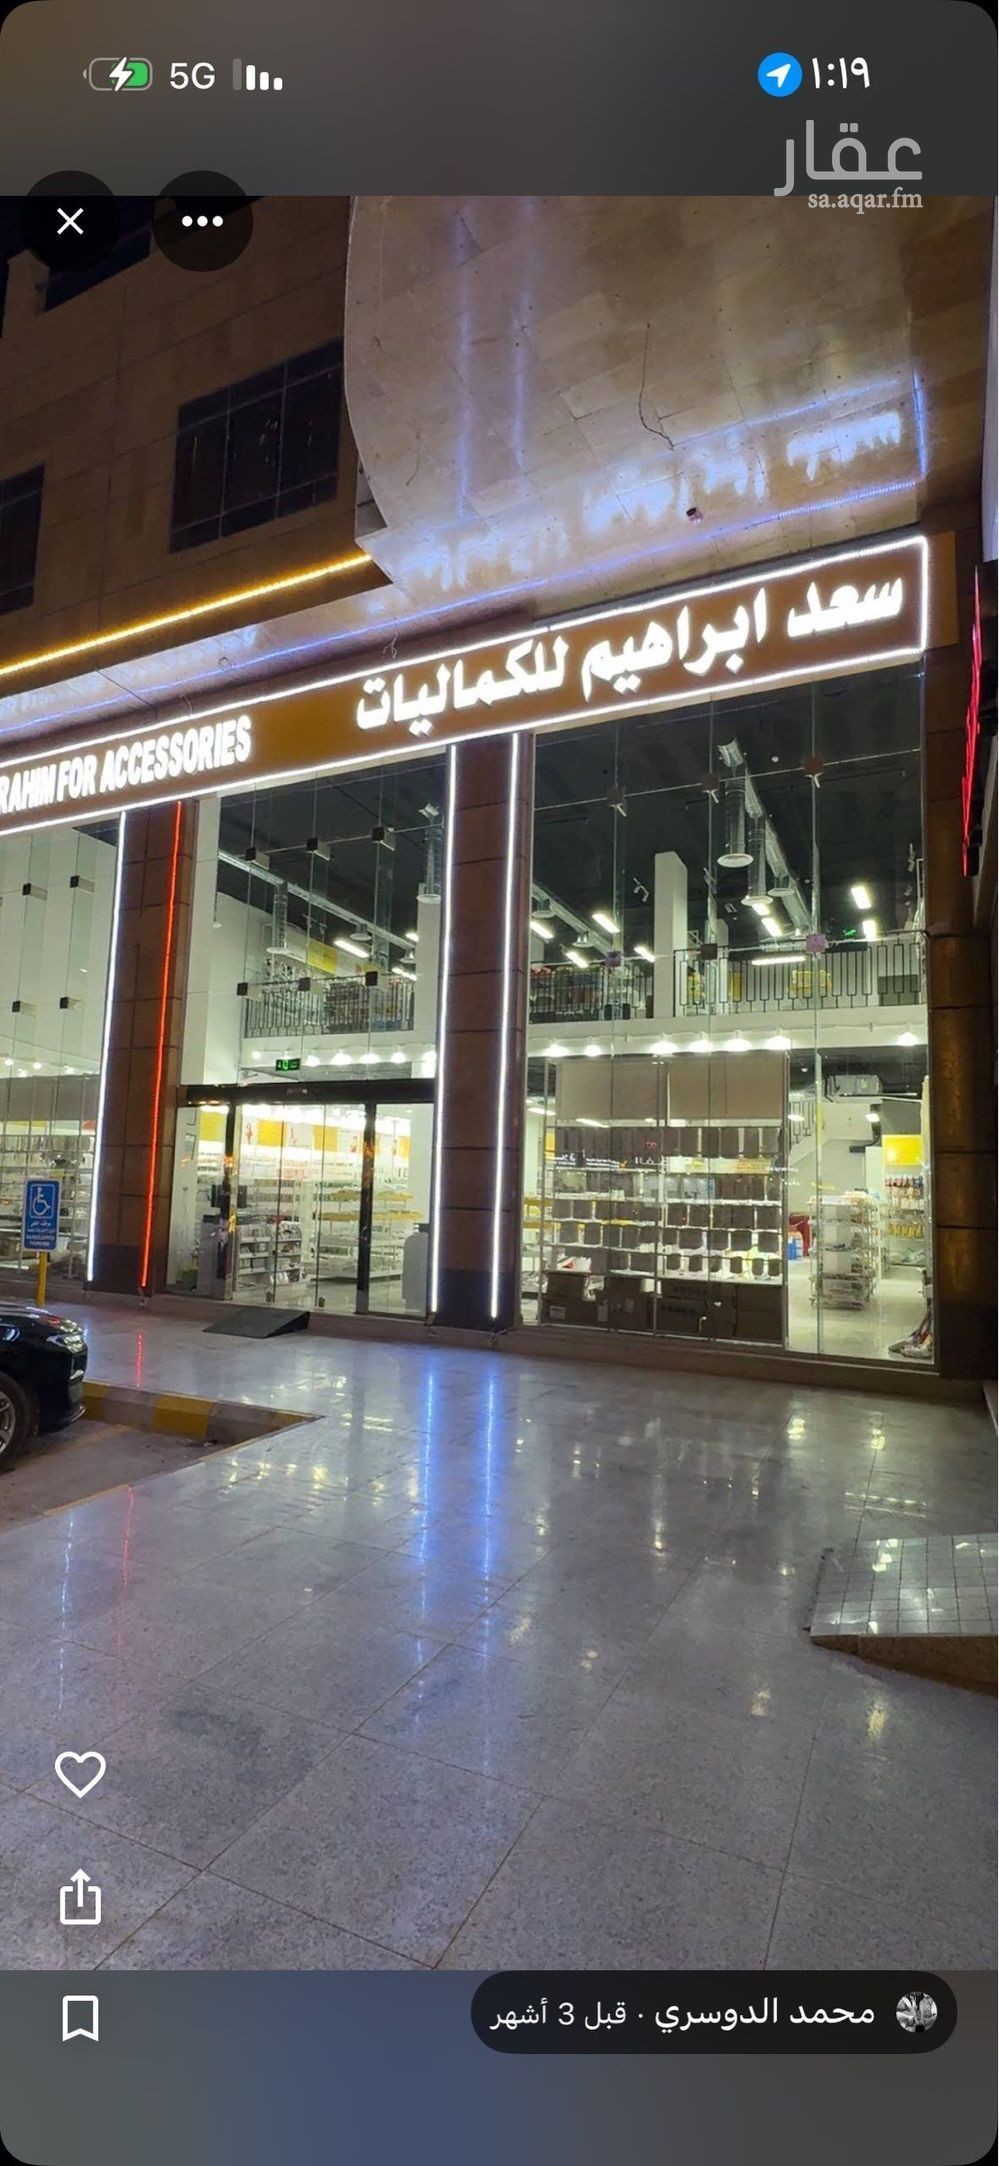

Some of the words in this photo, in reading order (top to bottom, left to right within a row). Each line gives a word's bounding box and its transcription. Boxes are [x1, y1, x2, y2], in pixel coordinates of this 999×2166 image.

[580, 586, 768, 701] ابراهيم
[786, 577, 904, 638] سعد
[354, 634, 570, 737] للكماليات
[56, 754, 98, 802] FOR
[99, 714, 253, 794] ACCESSORIES
